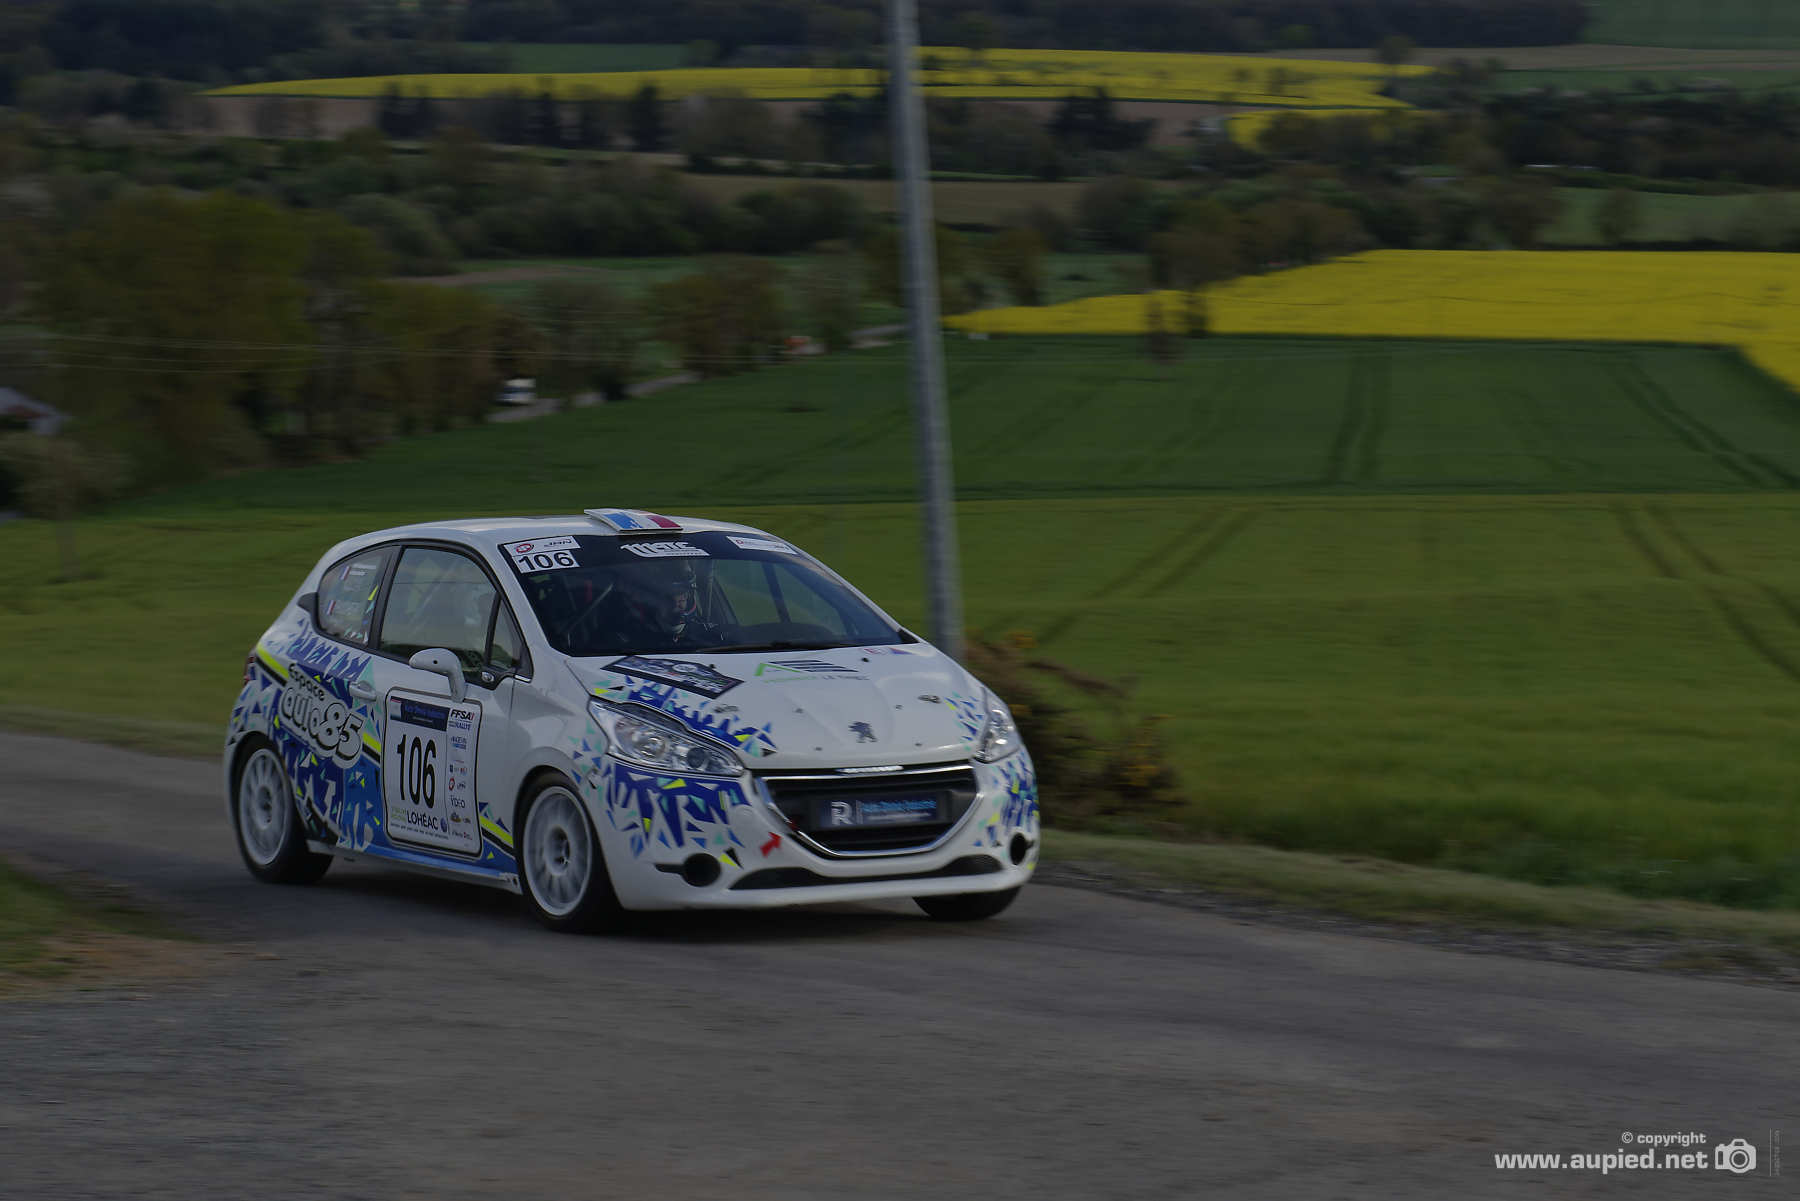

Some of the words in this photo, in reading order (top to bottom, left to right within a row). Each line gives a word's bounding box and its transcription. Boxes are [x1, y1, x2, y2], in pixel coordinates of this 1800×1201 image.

[519, 552, 574, 570] 106
[451, 709, 475, 721] FFSA
[397, 734, 436, 809] 106
